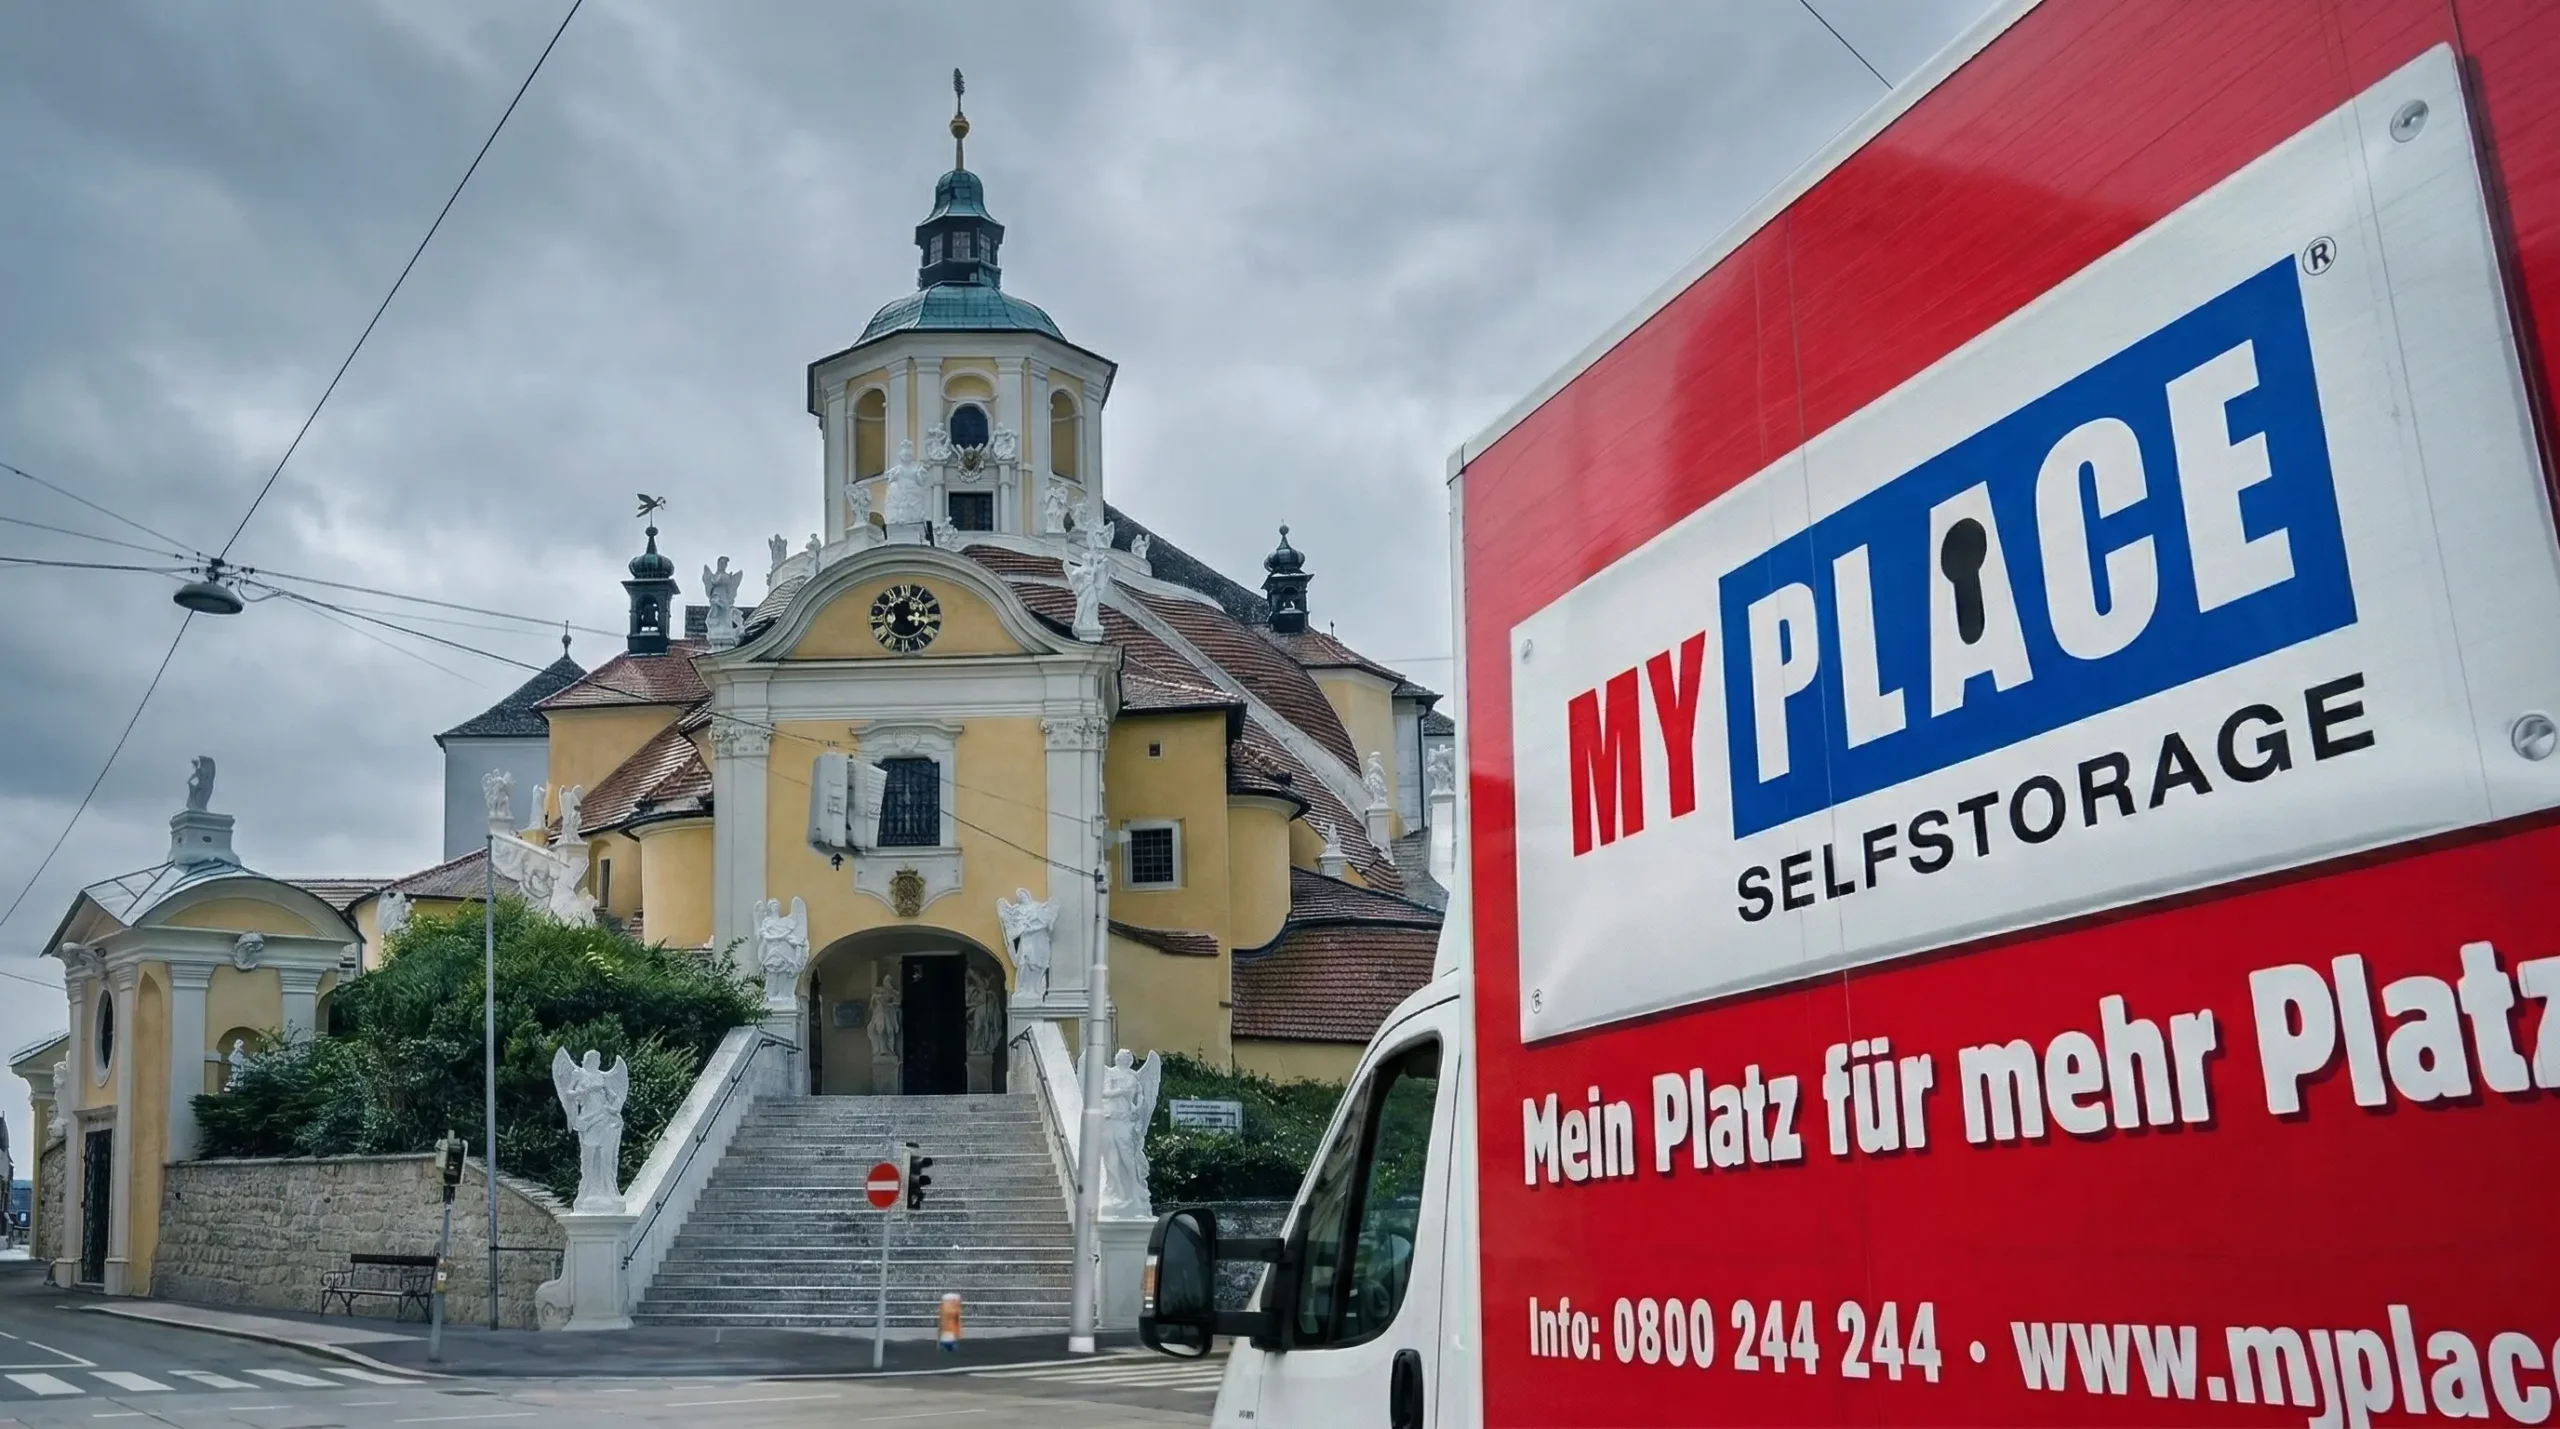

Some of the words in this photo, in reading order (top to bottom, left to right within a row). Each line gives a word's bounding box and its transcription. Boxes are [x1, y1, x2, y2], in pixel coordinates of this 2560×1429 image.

[1568, 630, 1706, 857] MY
[1747, 339, 2295, 784] PLACE
[1737, 672, 2375, 922] SELFSTORAGE
[1523, 1085, 1634, 1185] Mein
[1653, 1064, 1802, 1173] Platz
[1823, 1036, 1933, 1155] für
[1958, 994, 2216, 1144] mehr
[1529, 1297, 1601, 1361] Info:
[1613, 1297, 1715, 1369] 0800
[1731, 1299, 1819, 1375] 244
[1837, 1300, 1942, 1383] 244
